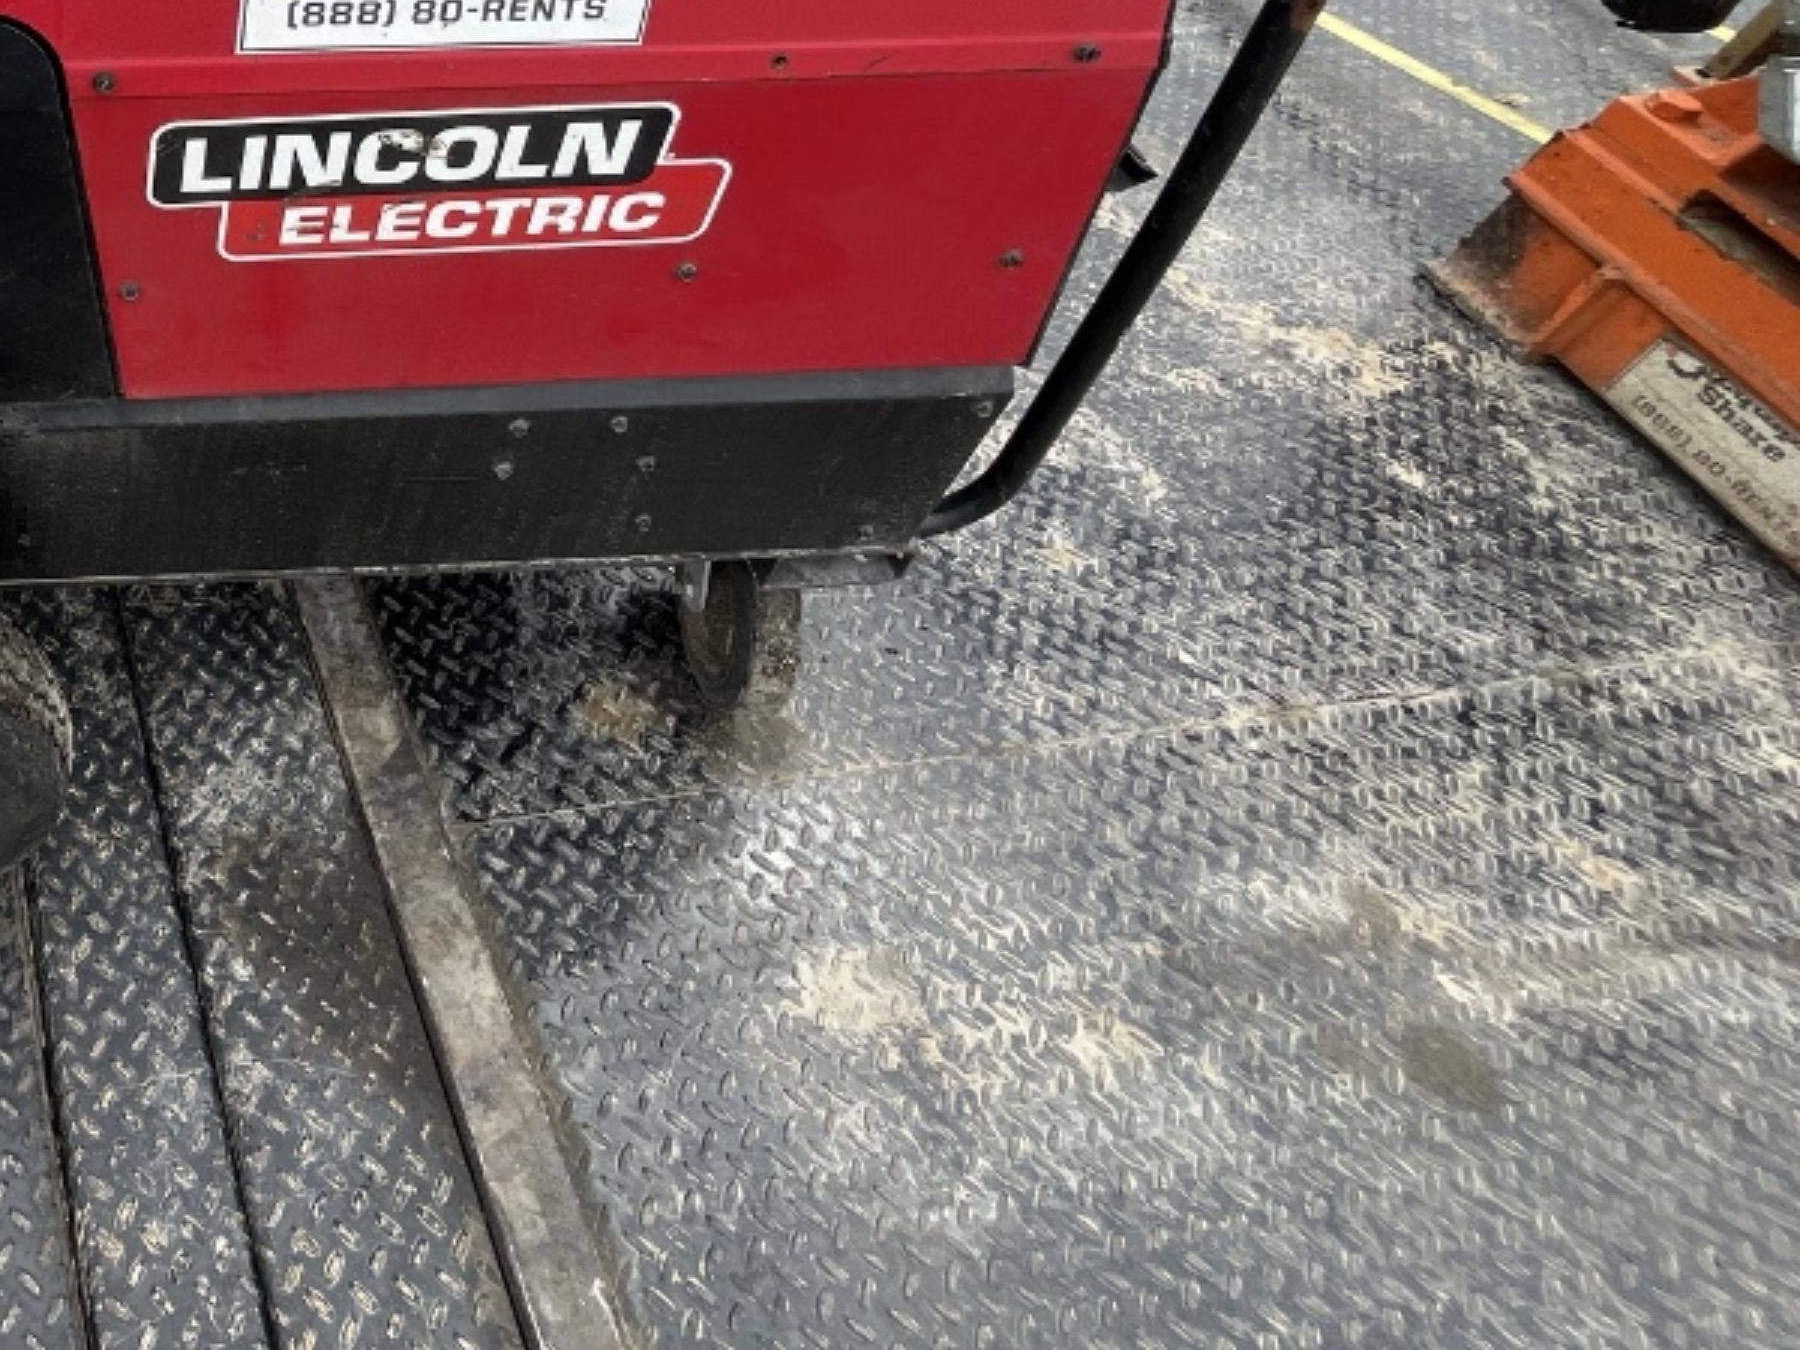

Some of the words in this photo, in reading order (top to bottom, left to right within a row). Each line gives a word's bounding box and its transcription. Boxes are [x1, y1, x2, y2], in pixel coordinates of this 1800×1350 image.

[179, 118, 643, 193] LINCOLN
[279, 191, 666, 246] ELECTRIC
[1697, 383, 1786, 462] Share
